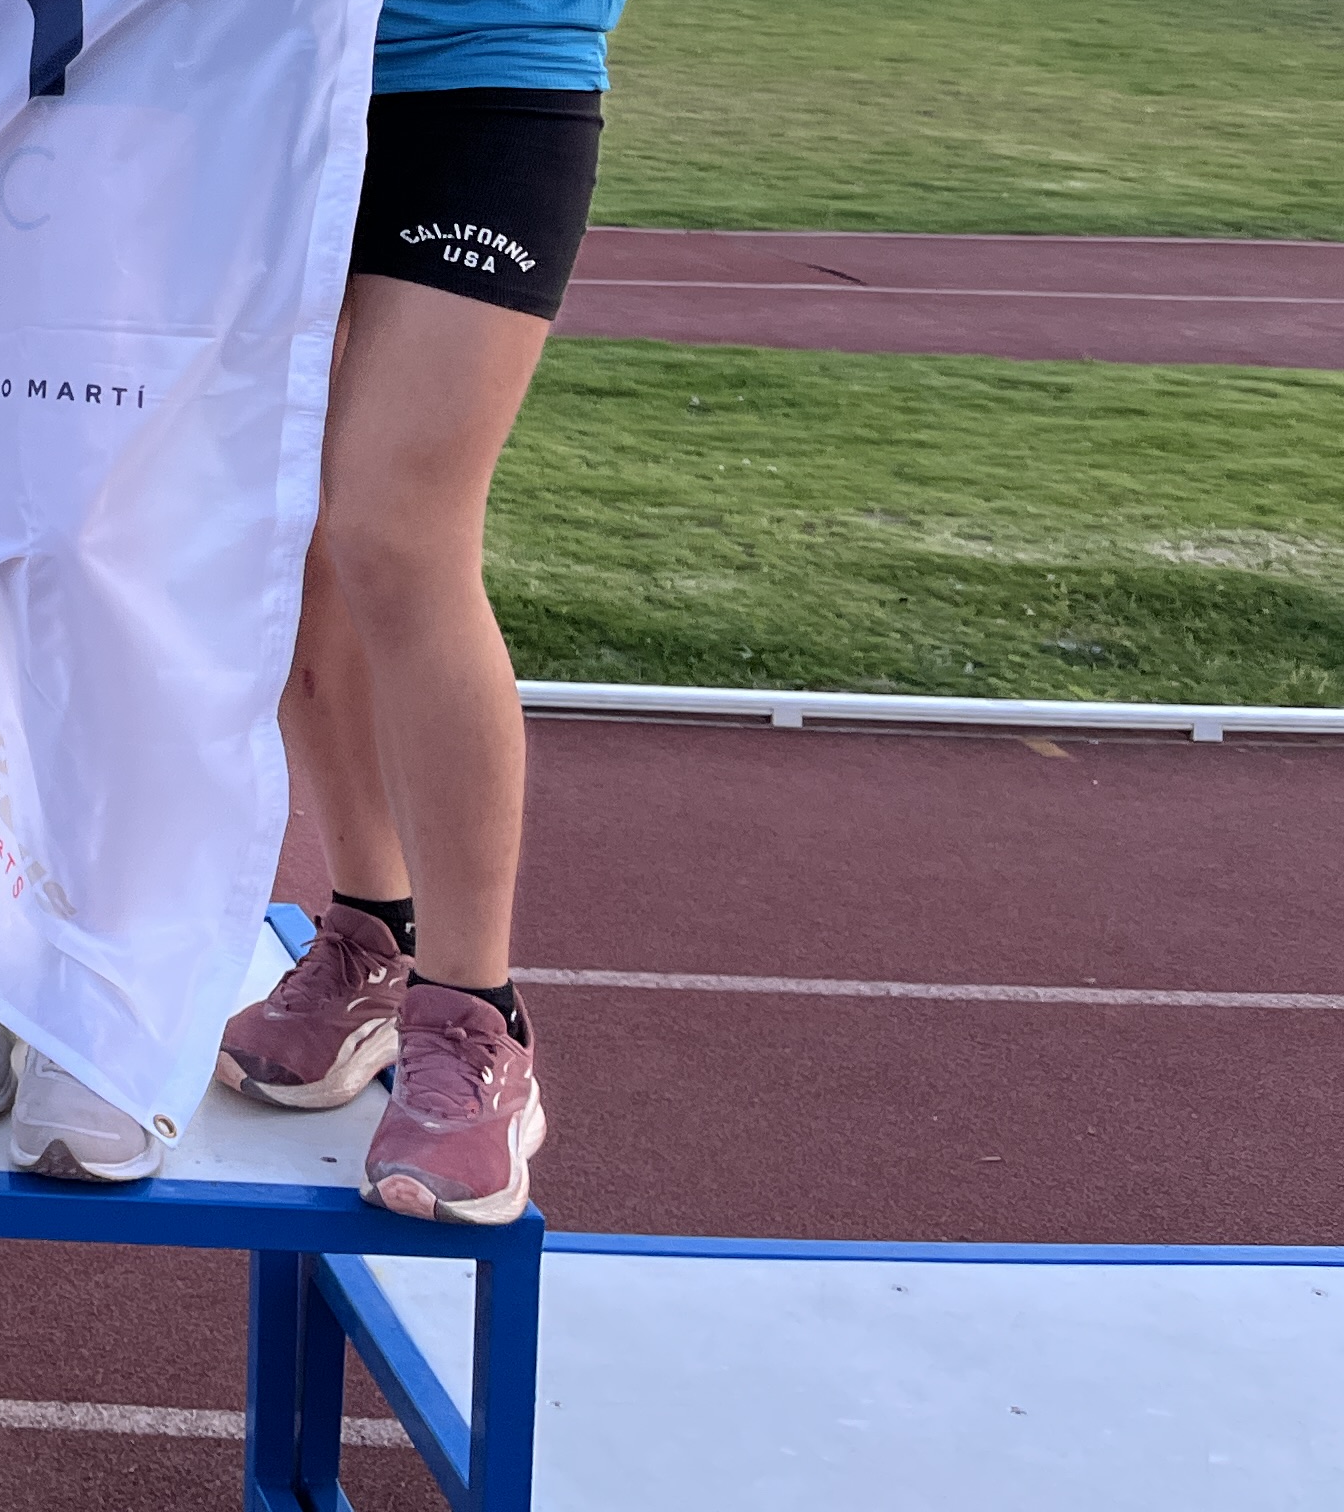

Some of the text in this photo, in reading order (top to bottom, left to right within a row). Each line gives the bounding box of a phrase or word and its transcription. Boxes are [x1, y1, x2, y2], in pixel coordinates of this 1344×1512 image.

[399, 223, 536, 273] CALIFORNIA
[443, 245, 495, 274] USA
[27, 378, 145, 409] MARTÍ
